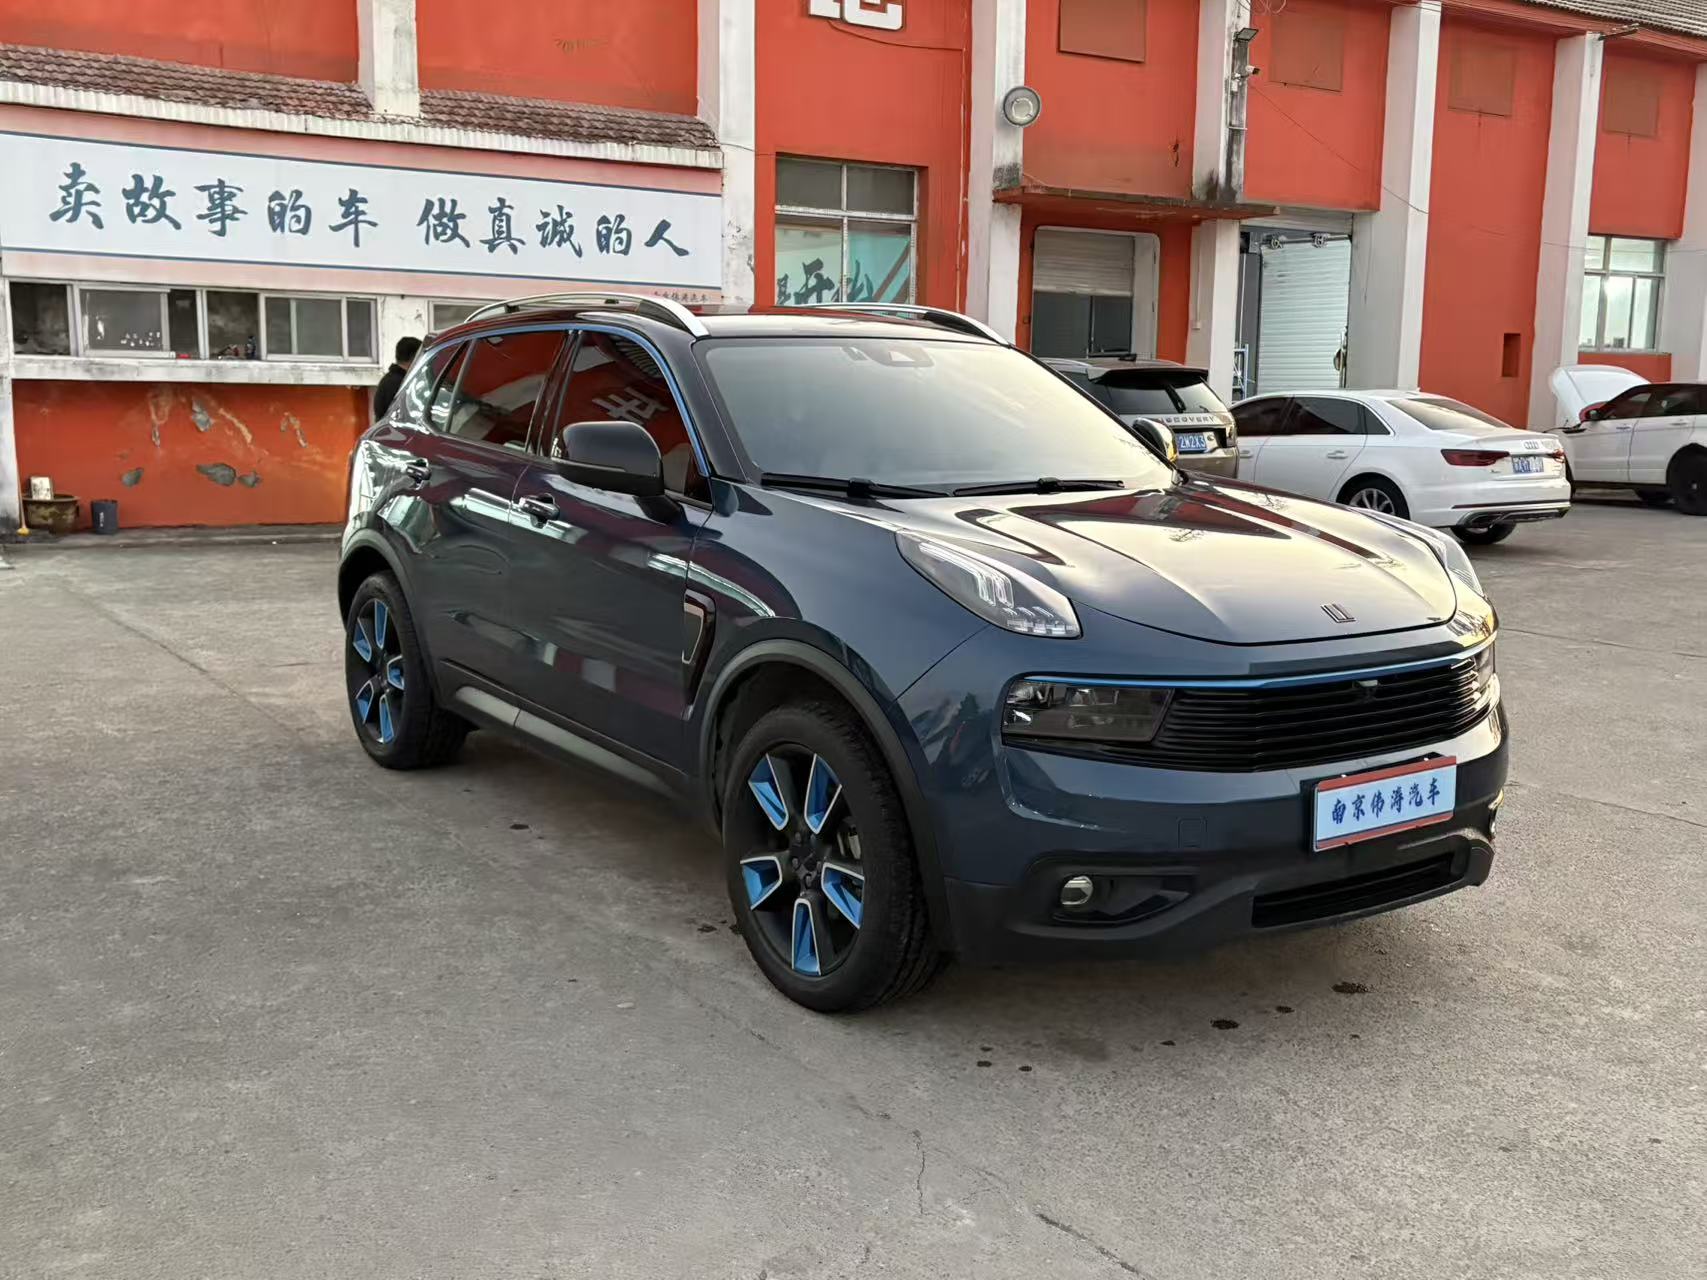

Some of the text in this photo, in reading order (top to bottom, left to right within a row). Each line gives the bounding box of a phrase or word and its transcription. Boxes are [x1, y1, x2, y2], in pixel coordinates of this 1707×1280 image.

[50, 162, 690, 258] 卖故事的车 做真诚的人
